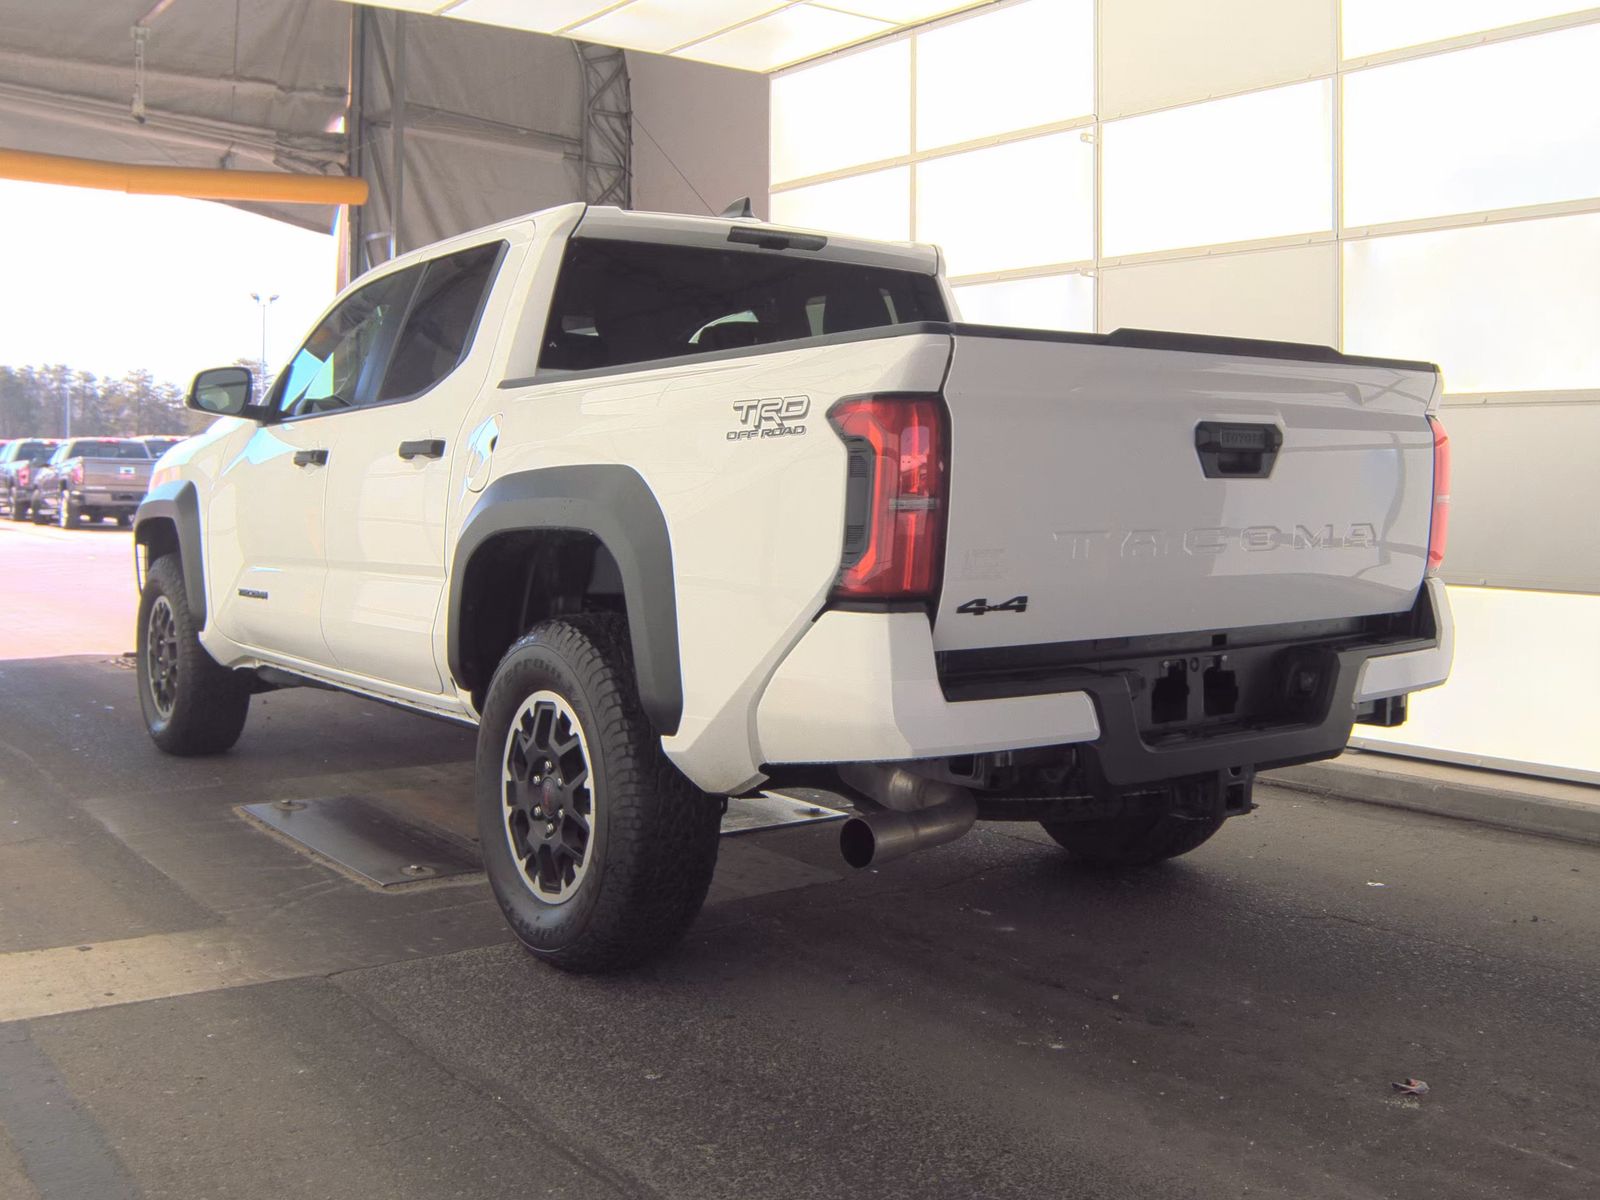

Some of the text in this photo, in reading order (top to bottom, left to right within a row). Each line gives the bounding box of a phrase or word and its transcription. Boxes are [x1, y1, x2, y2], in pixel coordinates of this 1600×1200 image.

[733, 395, 811, 429] TRD
[726, 425, 807, 441] OFF ROAD
[1053, 520, 1378, 560] TACOMA
